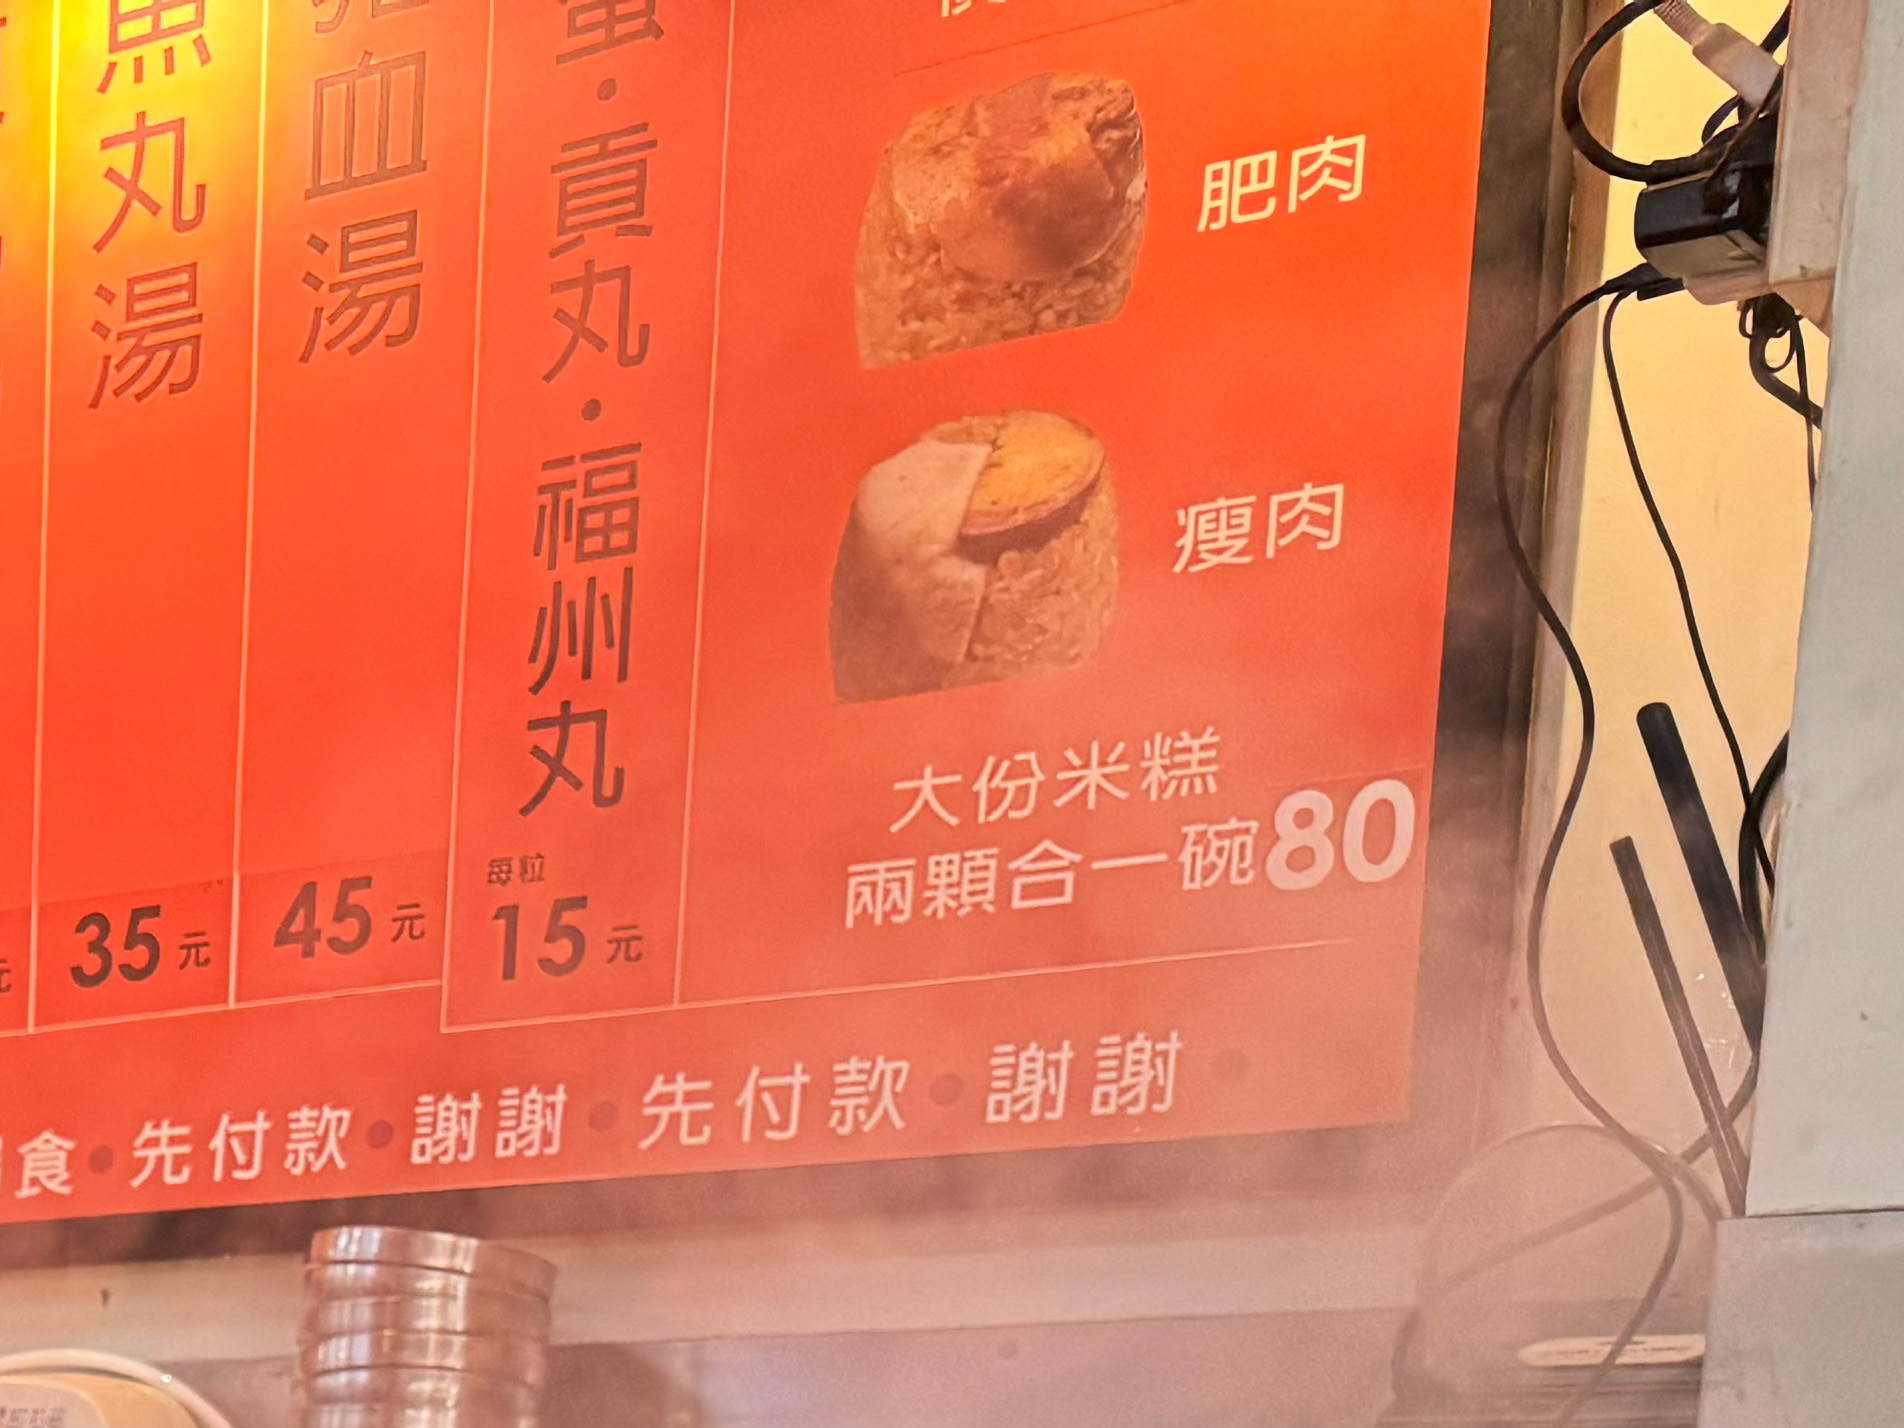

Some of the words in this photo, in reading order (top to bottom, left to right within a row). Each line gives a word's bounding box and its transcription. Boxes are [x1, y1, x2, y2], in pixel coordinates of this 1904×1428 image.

[298, 0, 430, 365] 血湯
[1197, 133, 1367, 234] 肥肉
[1172, 482, 1346, 575] 瘦肉
[889, 726, 1222, 834] 大份米糕
[129, 1105, 352, 1189] 先付款
[410, 1085, 567, 1166] 謝謝
[639, 1055, 911, 1150] 先付款
[987, 1030, 1183, 1125] 謝謝
